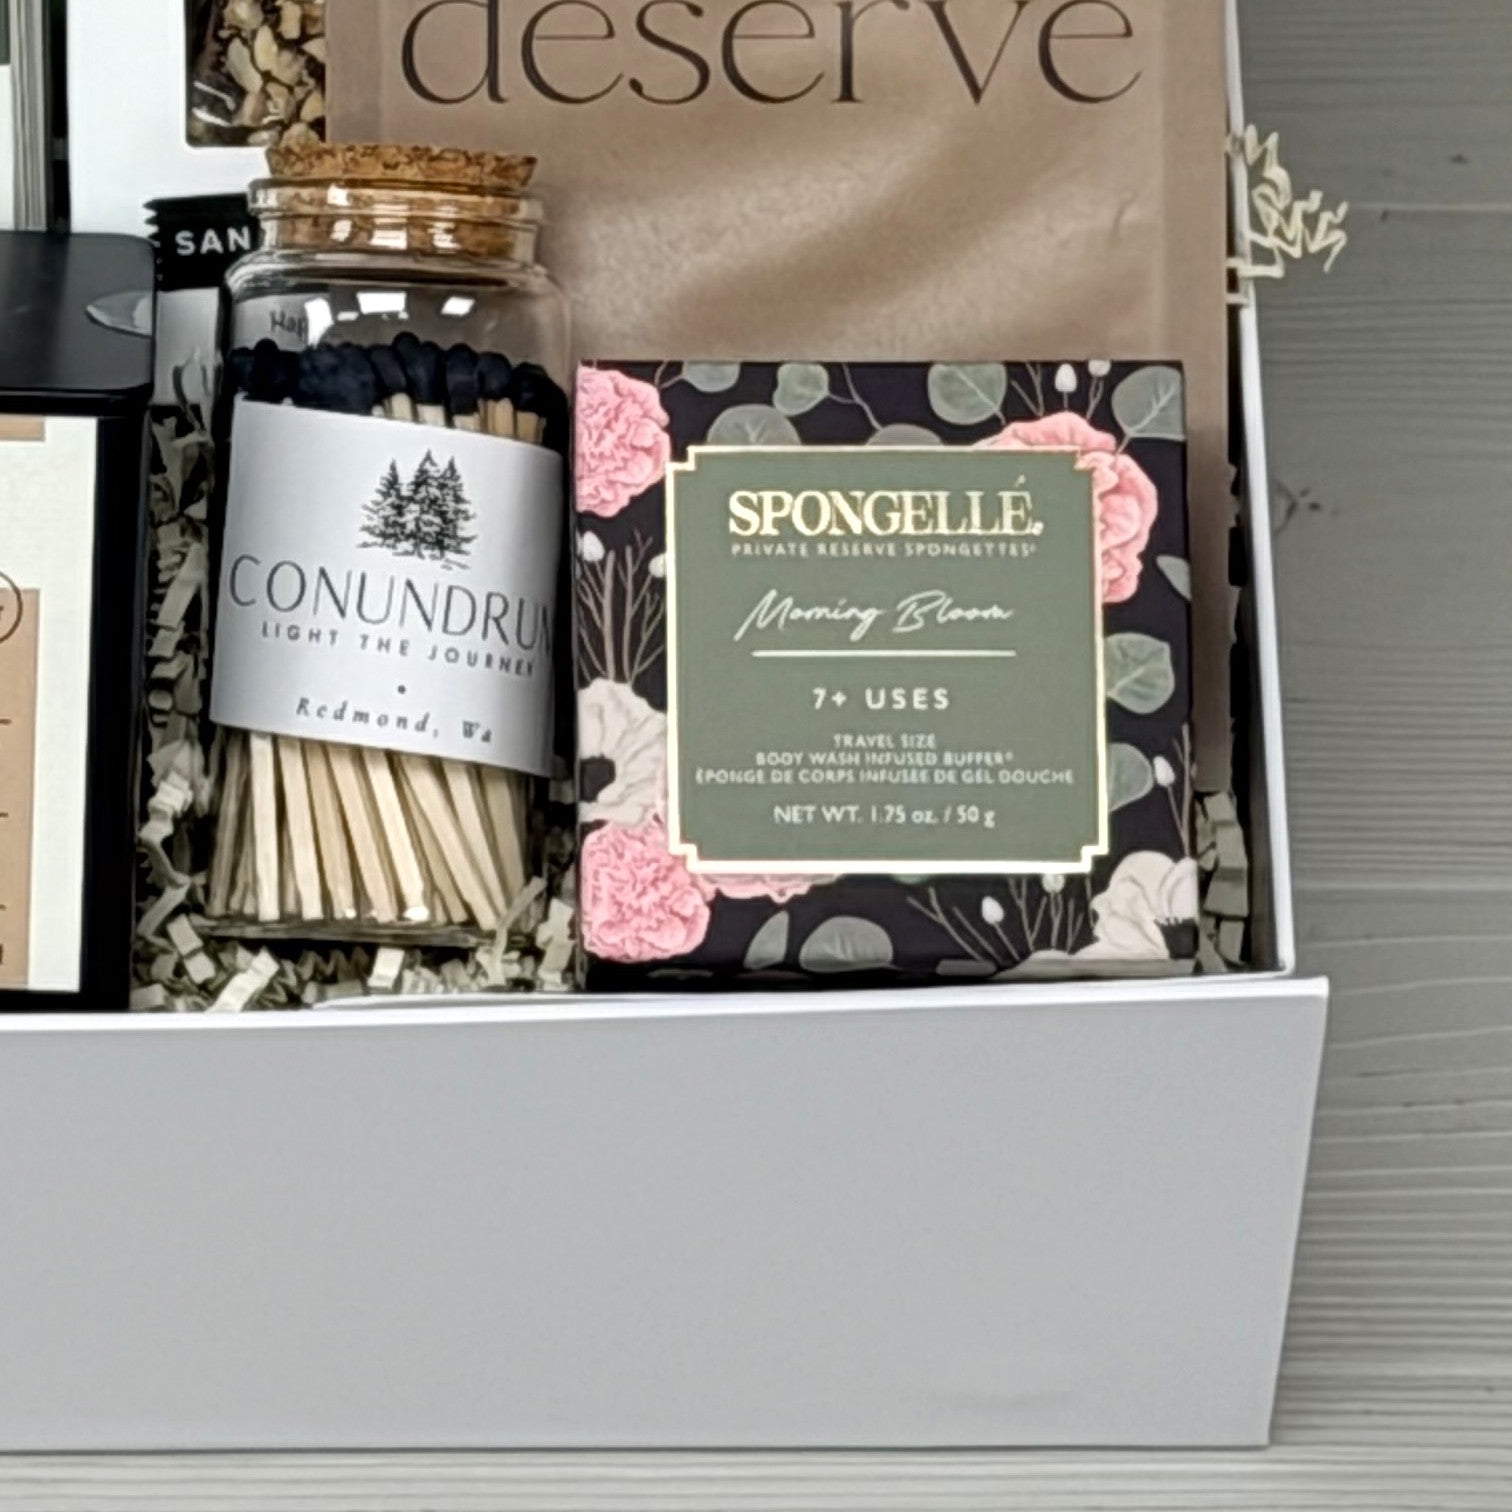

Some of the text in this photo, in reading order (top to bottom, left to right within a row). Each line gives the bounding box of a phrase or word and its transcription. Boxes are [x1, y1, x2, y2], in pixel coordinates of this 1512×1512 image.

[175, 225, 251, 256] SAN
[730, 542, 809, 558] PRIVATE
[816, 542, 896, 558] RESERVE
[733, 588, 1015, 642] Morning Bloom
[261, 619, 340, 648] LIGHT
[359, 633, 411, 658] THE
[813, 687, 950, 711] 7+ USES
[296, 697, 441, 740] Redmond,
[833, 733, 937, 749] TRAVEL SIZE
[755, 751, 803, 767] BODY
[808, 751, 860, 767] WASH
[864, 751, 938, 767] INFUSED
[770, 769, 791, 785] DE
[798, 768, 855, 785] CORPS
[933, 769, 957, 785] DE
[960, 769, 995, 785] GEL
[998, 769, 1075, 786] DOUCHE
[773, 804, 817, 824] NET
[821, 804, 865, 824] WT.
[870, 804, 906, 824] 1.75
[942, 804, 953, 825] /
[955, 804, 980, 824] 50
[982, 808, 997, 829] g
